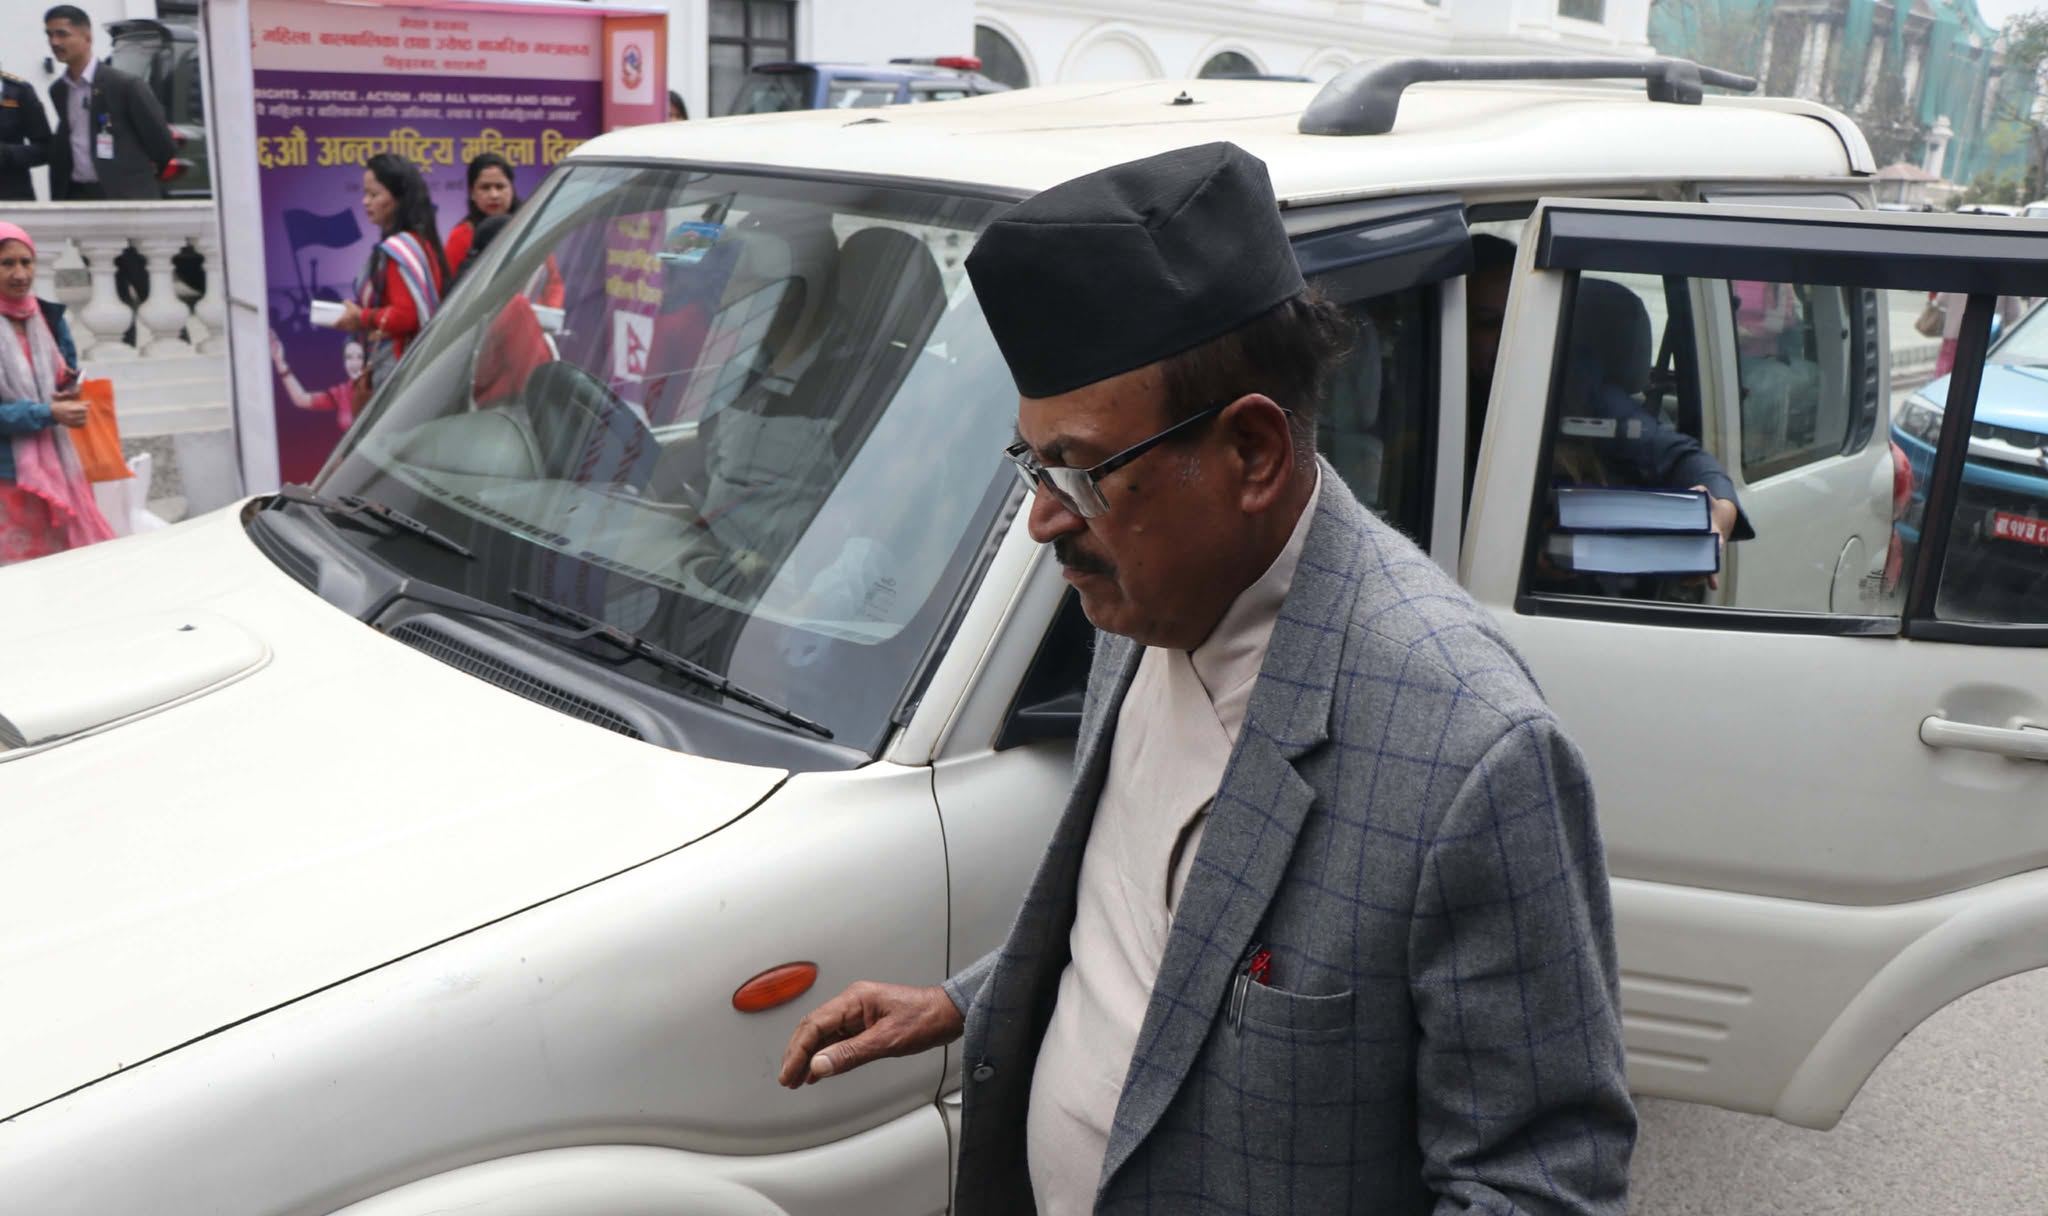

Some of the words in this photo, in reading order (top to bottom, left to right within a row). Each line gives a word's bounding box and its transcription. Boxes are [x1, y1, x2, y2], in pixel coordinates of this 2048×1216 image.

[308, 90, 357, 101] JUSTICE
[366, 91, 411, 102] ACTION
[418, 93, 442, 103] FOR
[445, 93, 465, 104] ALL
[468, 94, 513, 105] WOMEN
[515, 95, 539, 105] AND
[461, 128, 535, 167] महिला
